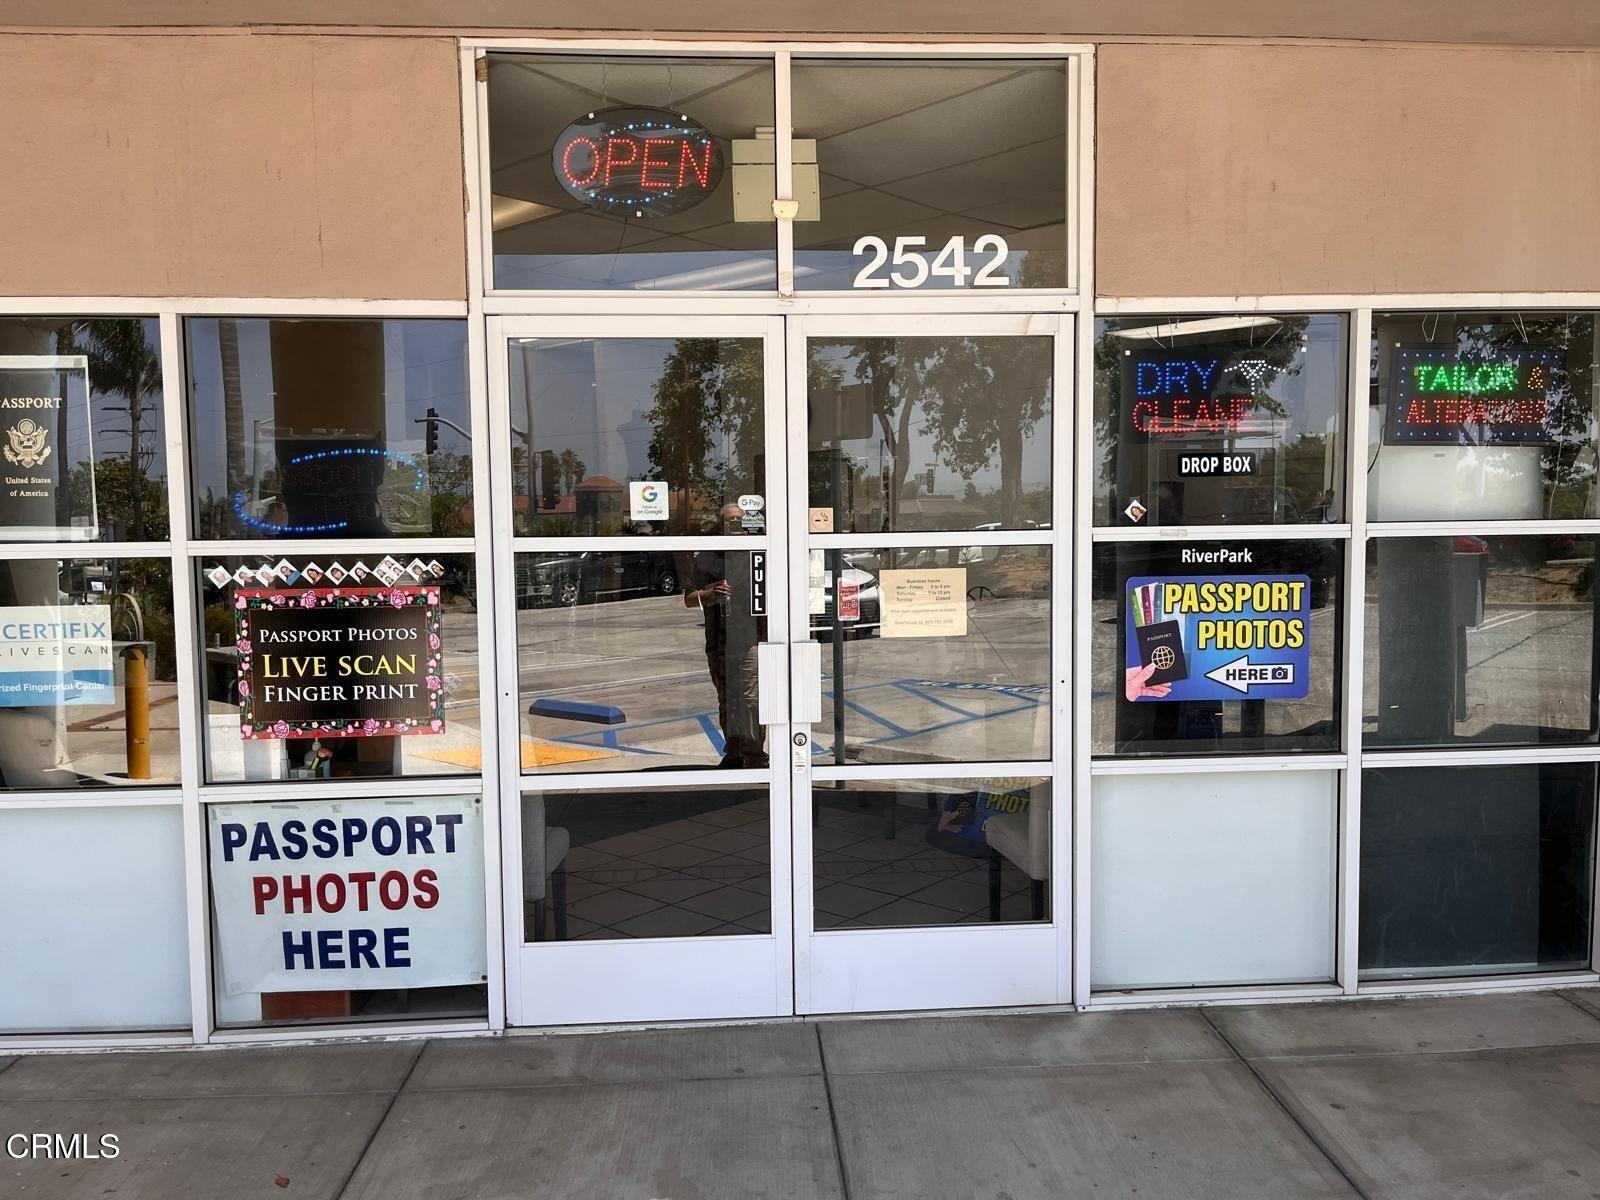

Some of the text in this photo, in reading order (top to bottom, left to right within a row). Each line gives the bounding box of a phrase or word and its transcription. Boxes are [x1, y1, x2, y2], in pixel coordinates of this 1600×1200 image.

[563, 137, 712, 188] OPEN
[852, 234, 1010, 289] 2542
[1137, 359, 1217, 395] DRY
[1417, 365, 1544, 391] TAILOR &
[0, 397, 62, 409] ASSPORT
[1132, 399, 1252, 432] CLEANE
[1181, 456, 1252, 474] DROP BOX
[5, 477, 52, 485] United States
[640, 485, 658, 503] G
[749, 499, 761, 508] Pay
[644, 508, 663, 516] Google
[1182, 547, 1253, 563] RiverPark
[754, 555, 763, 611] PULL
[1164, 581, 1305, 613] PASSPORT
[3, 622, 107, 640] CERTIFIX
[259, 627, 418, 643] PASSPORT PHOTOS
[1147, 633, 1172, 642] PASSPORT
[1197, 618, 1304, 650] PHOTOS
[0, 645, 108, 657] IVESCAN
[262, 654, 417, 679] LIVE SCAN
[1225, 668, 1269, 681] HERE
[264, 684, 418, 702] FINGER PRINT
[985, 794, 1030, 814] PHOT
[221, 813, 463, 861] PASSPORT
[252, 869, 440, 915] PHOTOS
[282, 927, 411, 970] HERE
